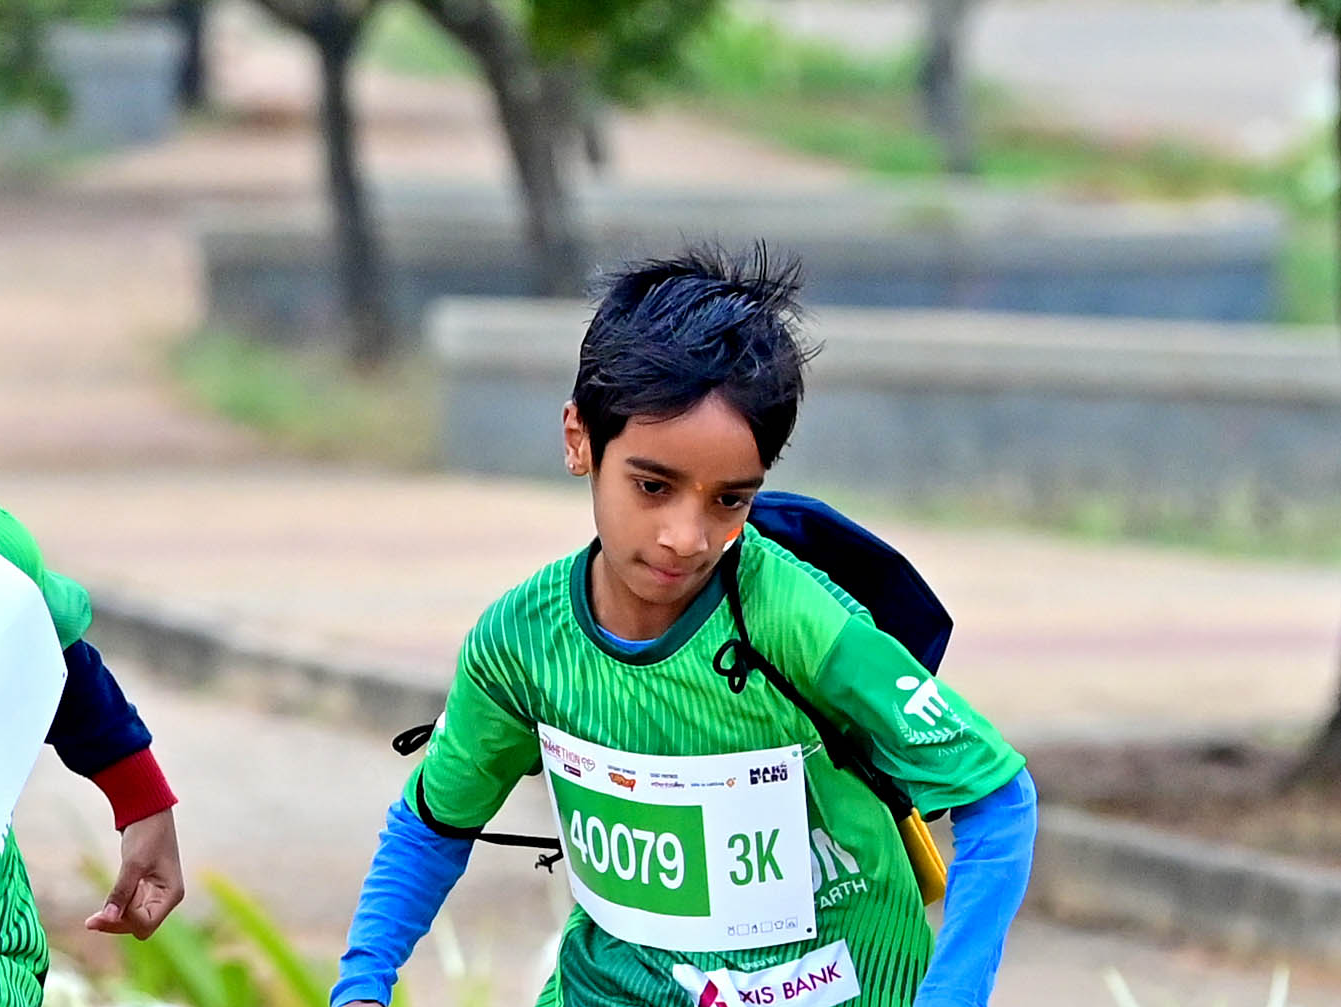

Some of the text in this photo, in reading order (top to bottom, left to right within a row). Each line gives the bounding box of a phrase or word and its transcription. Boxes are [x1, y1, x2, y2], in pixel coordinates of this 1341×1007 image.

[570, 810, 685, 889] 40079
[727, 828, 784, 887] 3K
[815, 878, 868, 910] ARTH
[737, 986, 775, 1006] XIS
[782, 960, 842, 1000] BANK
